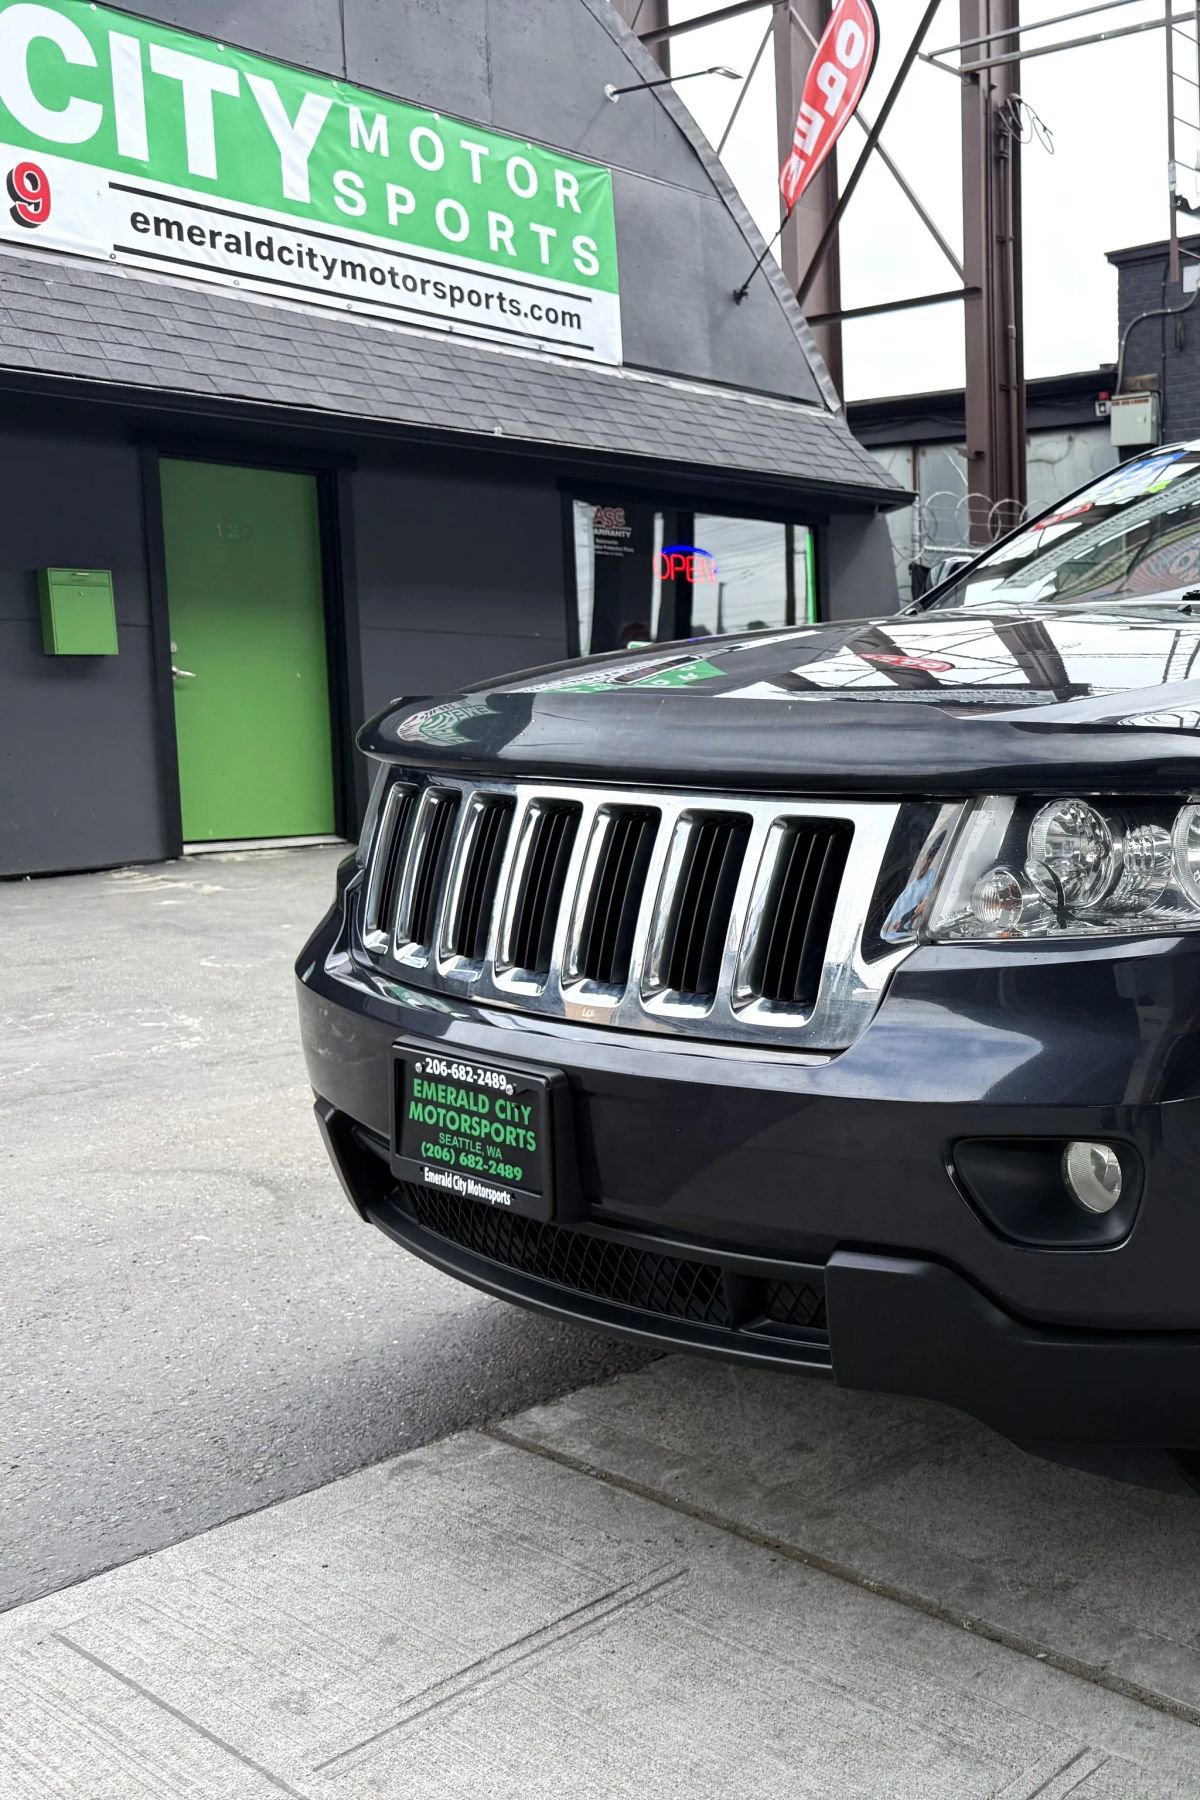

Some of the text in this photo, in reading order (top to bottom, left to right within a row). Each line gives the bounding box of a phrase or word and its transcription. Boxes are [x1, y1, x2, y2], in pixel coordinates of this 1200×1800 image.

[0, 4, 334, 204] CITY
[347, 108, 583, 215] MOTOR
[332, 169, 600, 277] SPORTS
[129, 209, 583, 331] emeraldcitymotorsports.com
[592, 528, 632, 539] ARRANTY
[653, 553, 718, 586] OPEN
[425, 1057, 507, 1091] 206-682-2489
[412, 1078, 532, 1126] EMERALD CITY
[408, 1101, 537, 1152] MOTORSPORTS
[438, 1132, 503, 1160] SEATTLE, WA
[421, 1141, 523, 1181] (206) 682-2489
[424, 1166, 511, 1206] Emerald City Motorsports
